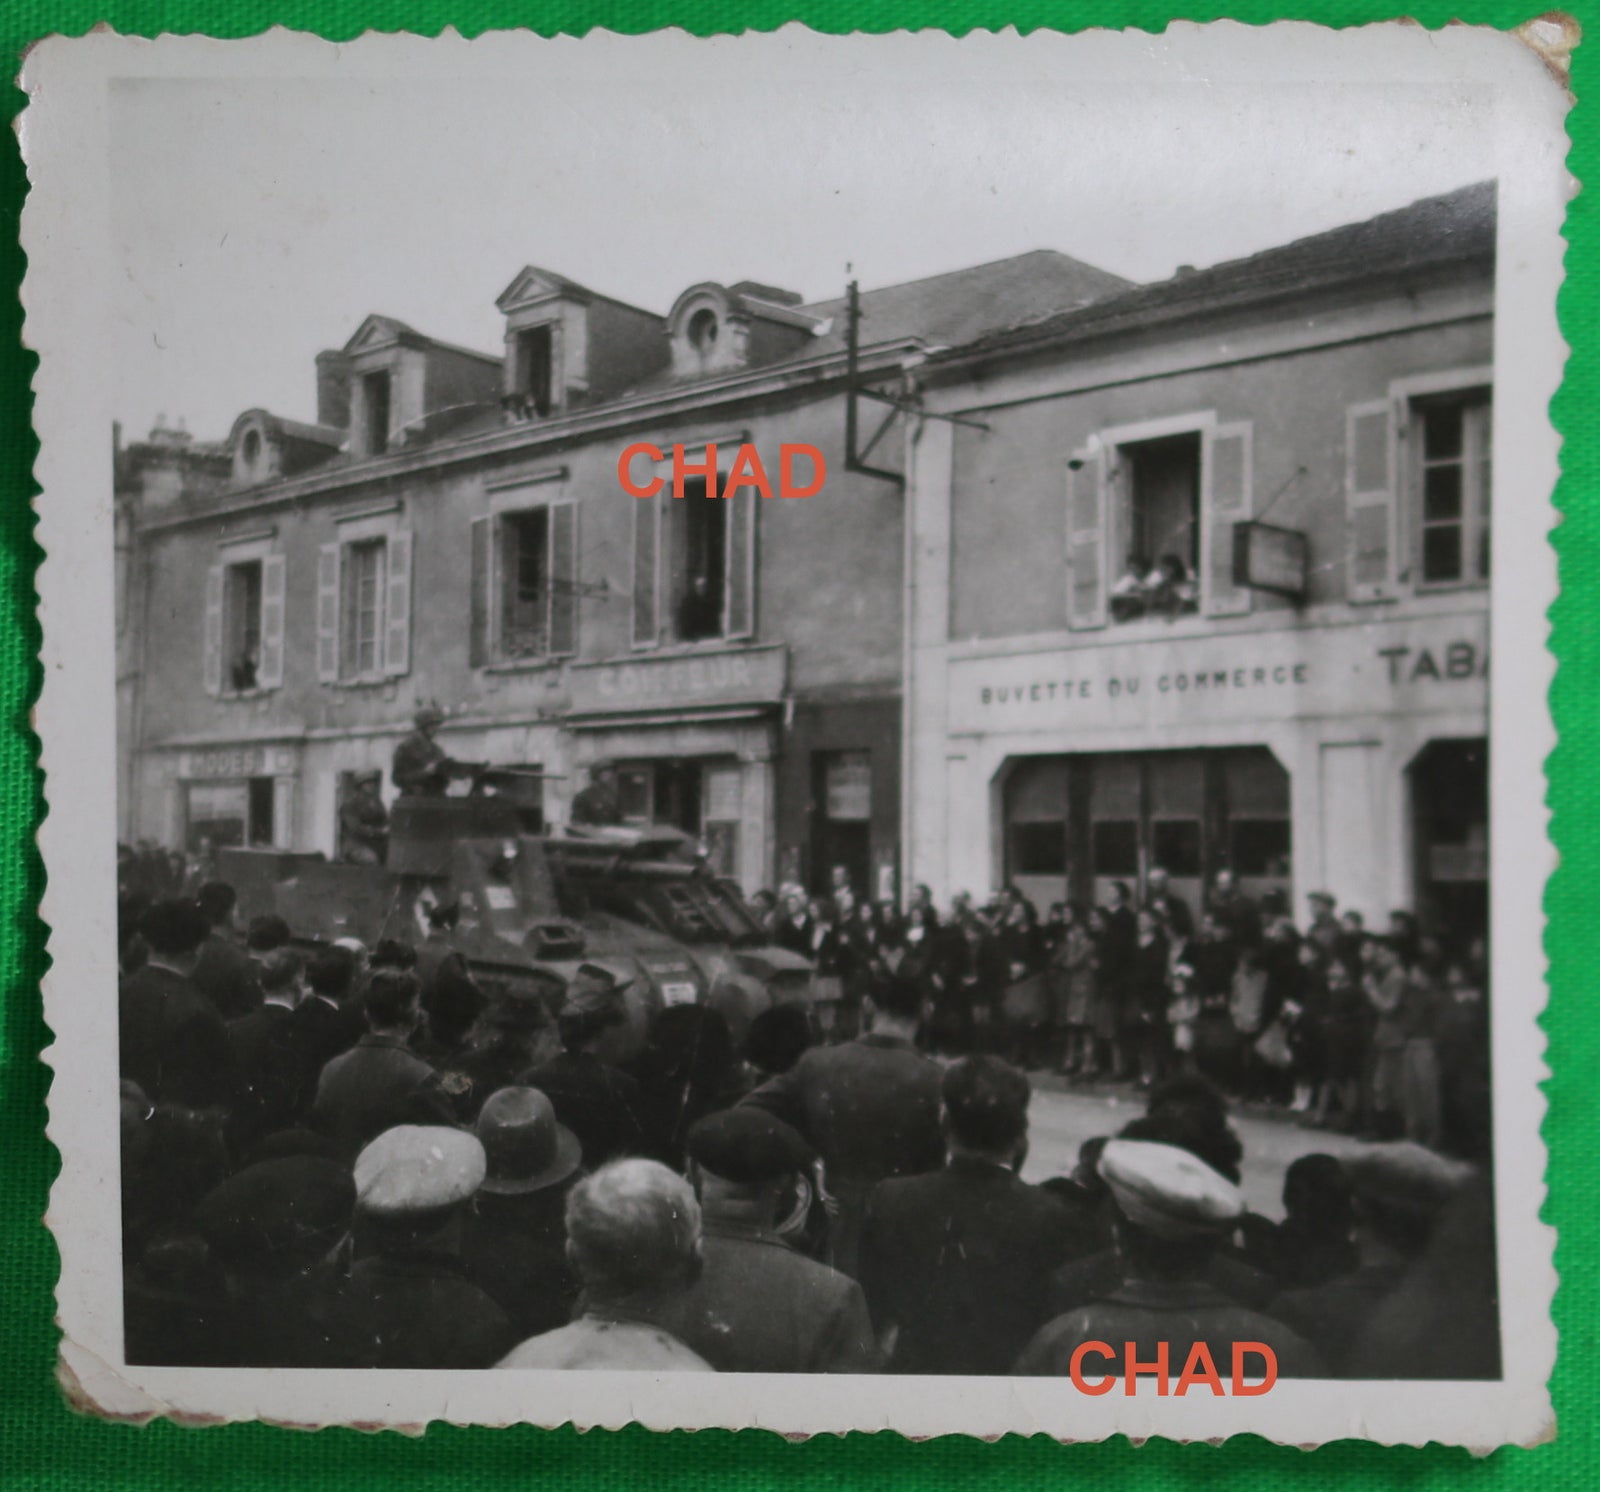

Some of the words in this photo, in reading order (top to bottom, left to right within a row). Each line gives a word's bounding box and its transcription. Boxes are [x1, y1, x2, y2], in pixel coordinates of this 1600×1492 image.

[597, 656, 751, 696] COIFFEUR
[978, 678, 1092, 705] BUVETTE
[1107, 676, 1140, 698] DU
[1157, 663, 1309, 694] COMMERCE
